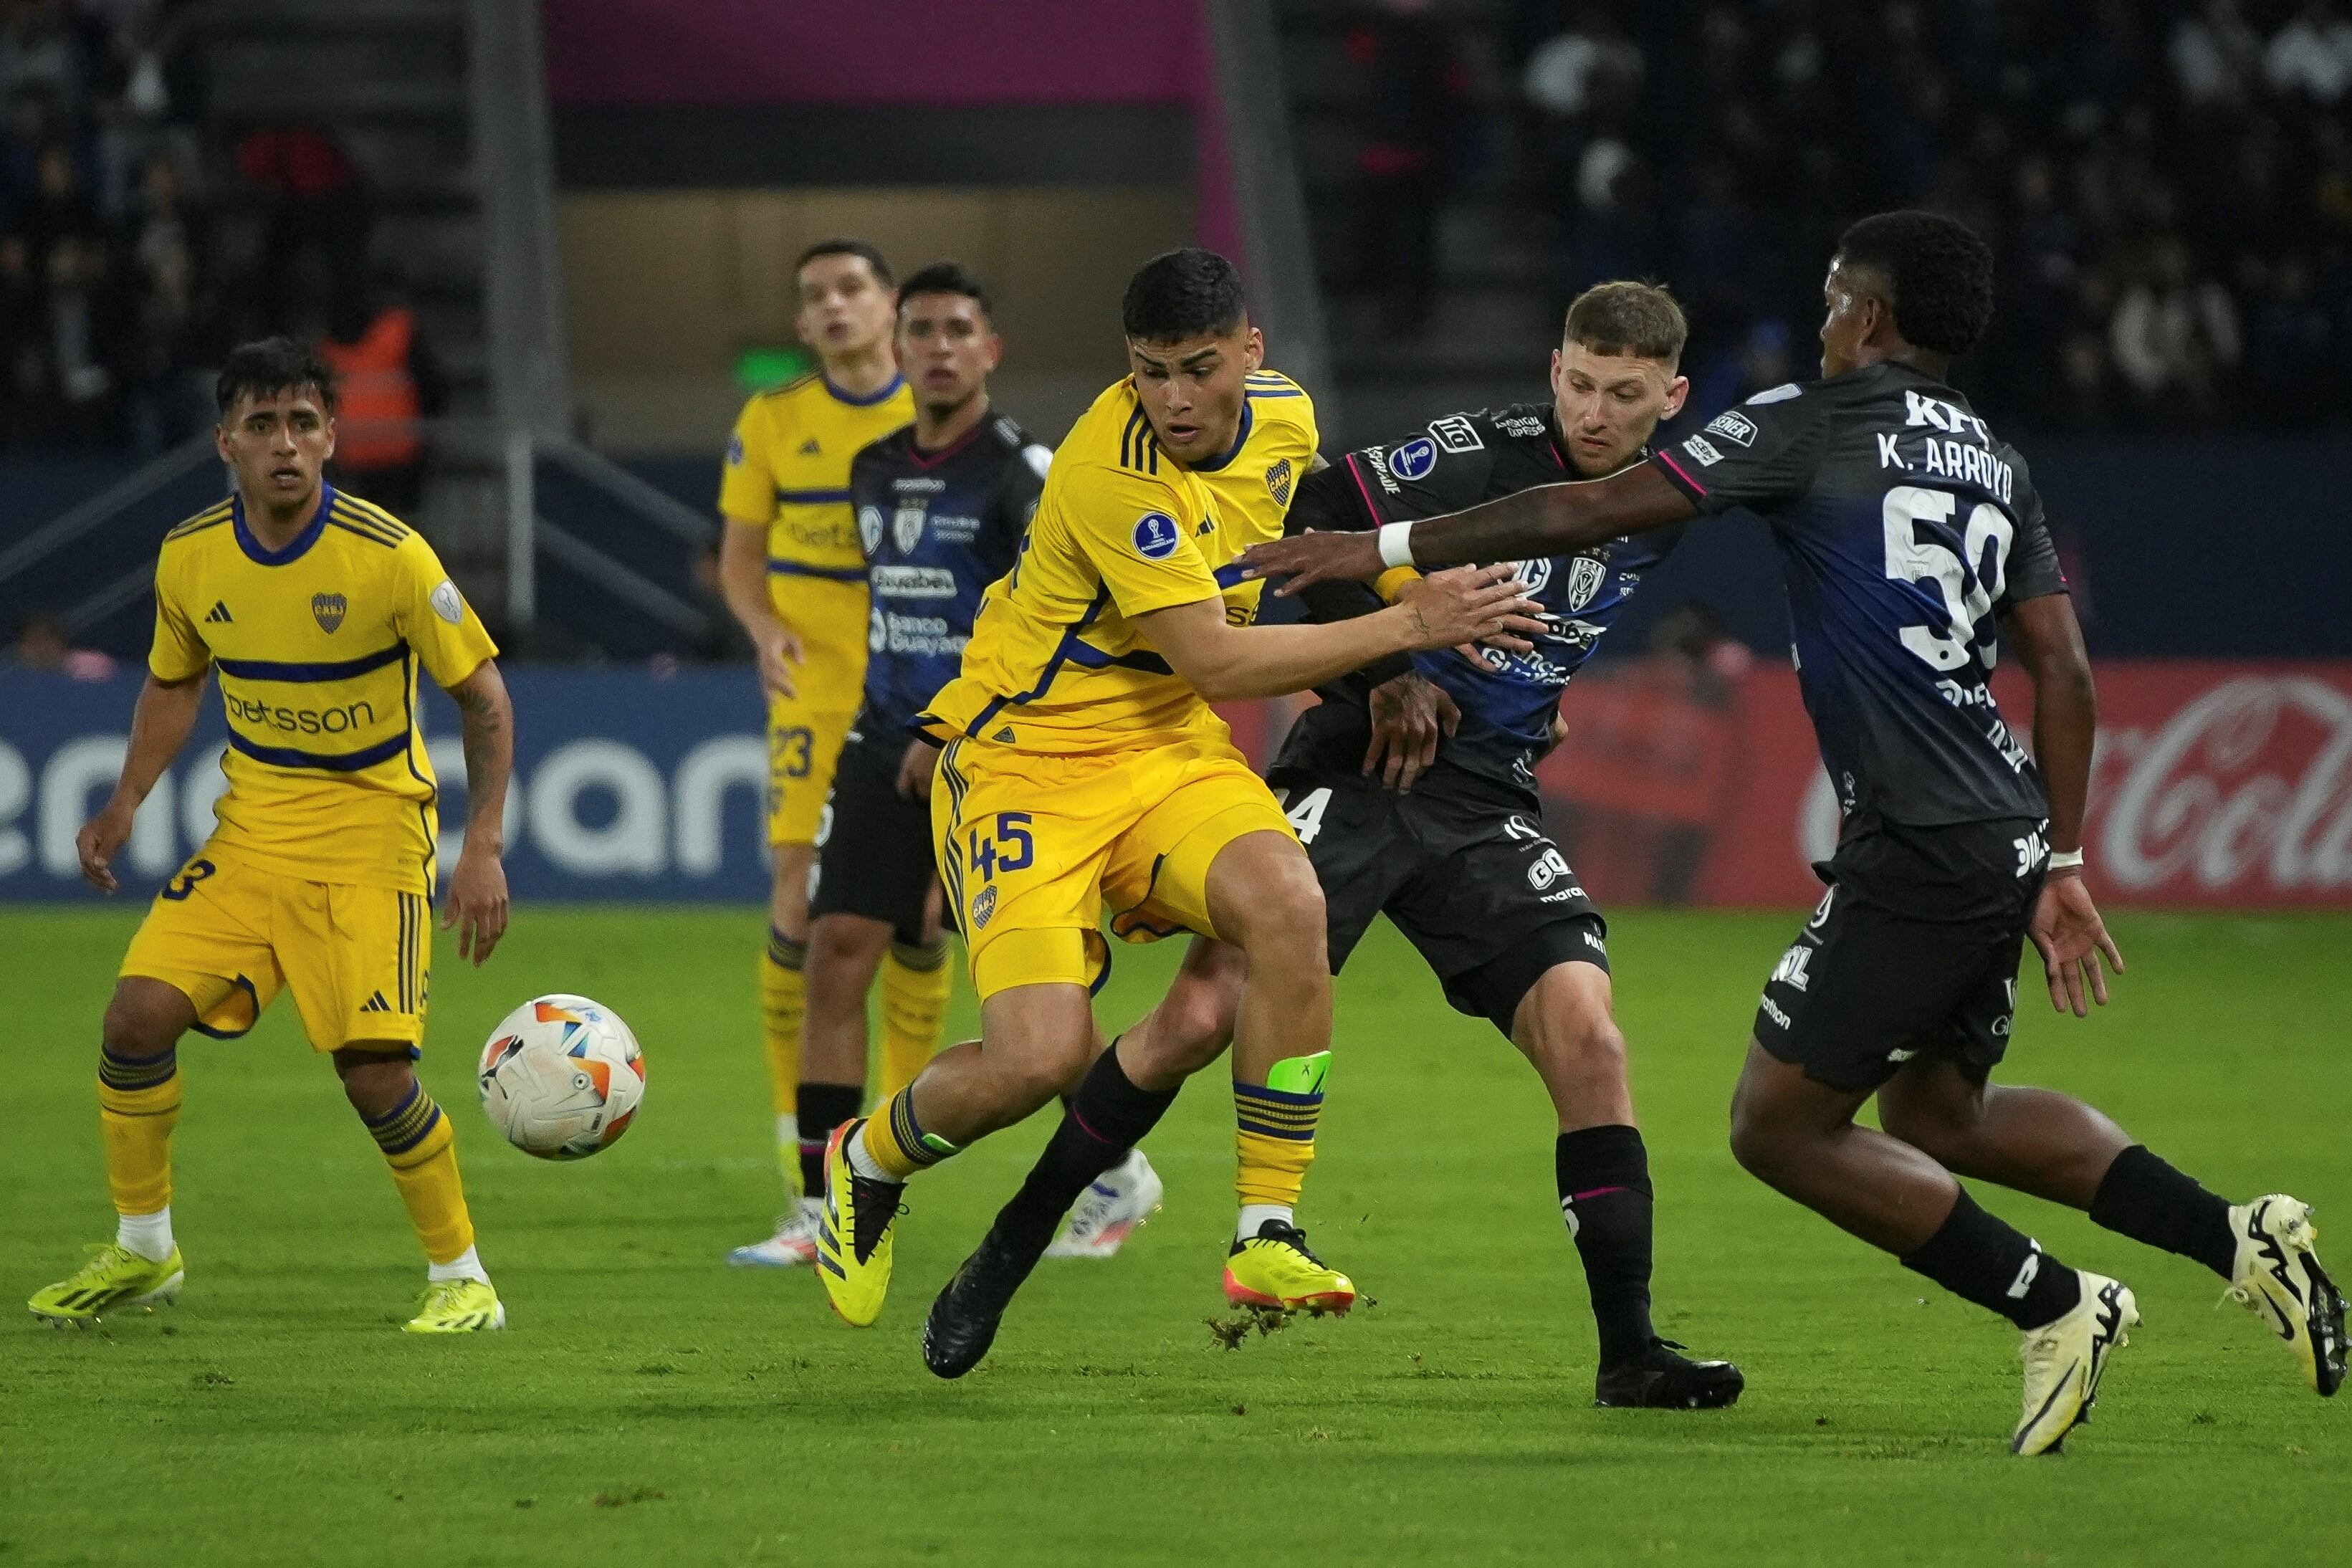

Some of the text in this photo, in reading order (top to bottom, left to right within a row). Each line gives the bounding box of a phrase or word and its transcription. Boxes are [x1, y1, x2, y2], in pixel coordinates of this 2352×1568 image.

[1269, 470, 1290, 492] CABJ
[1877, 432, 2012, 505] K. ARROYO
[1883, 485, 2014, 671] 50
[224, 684, 375, 735] betsson
[969, 811, 1033, 883] 45
